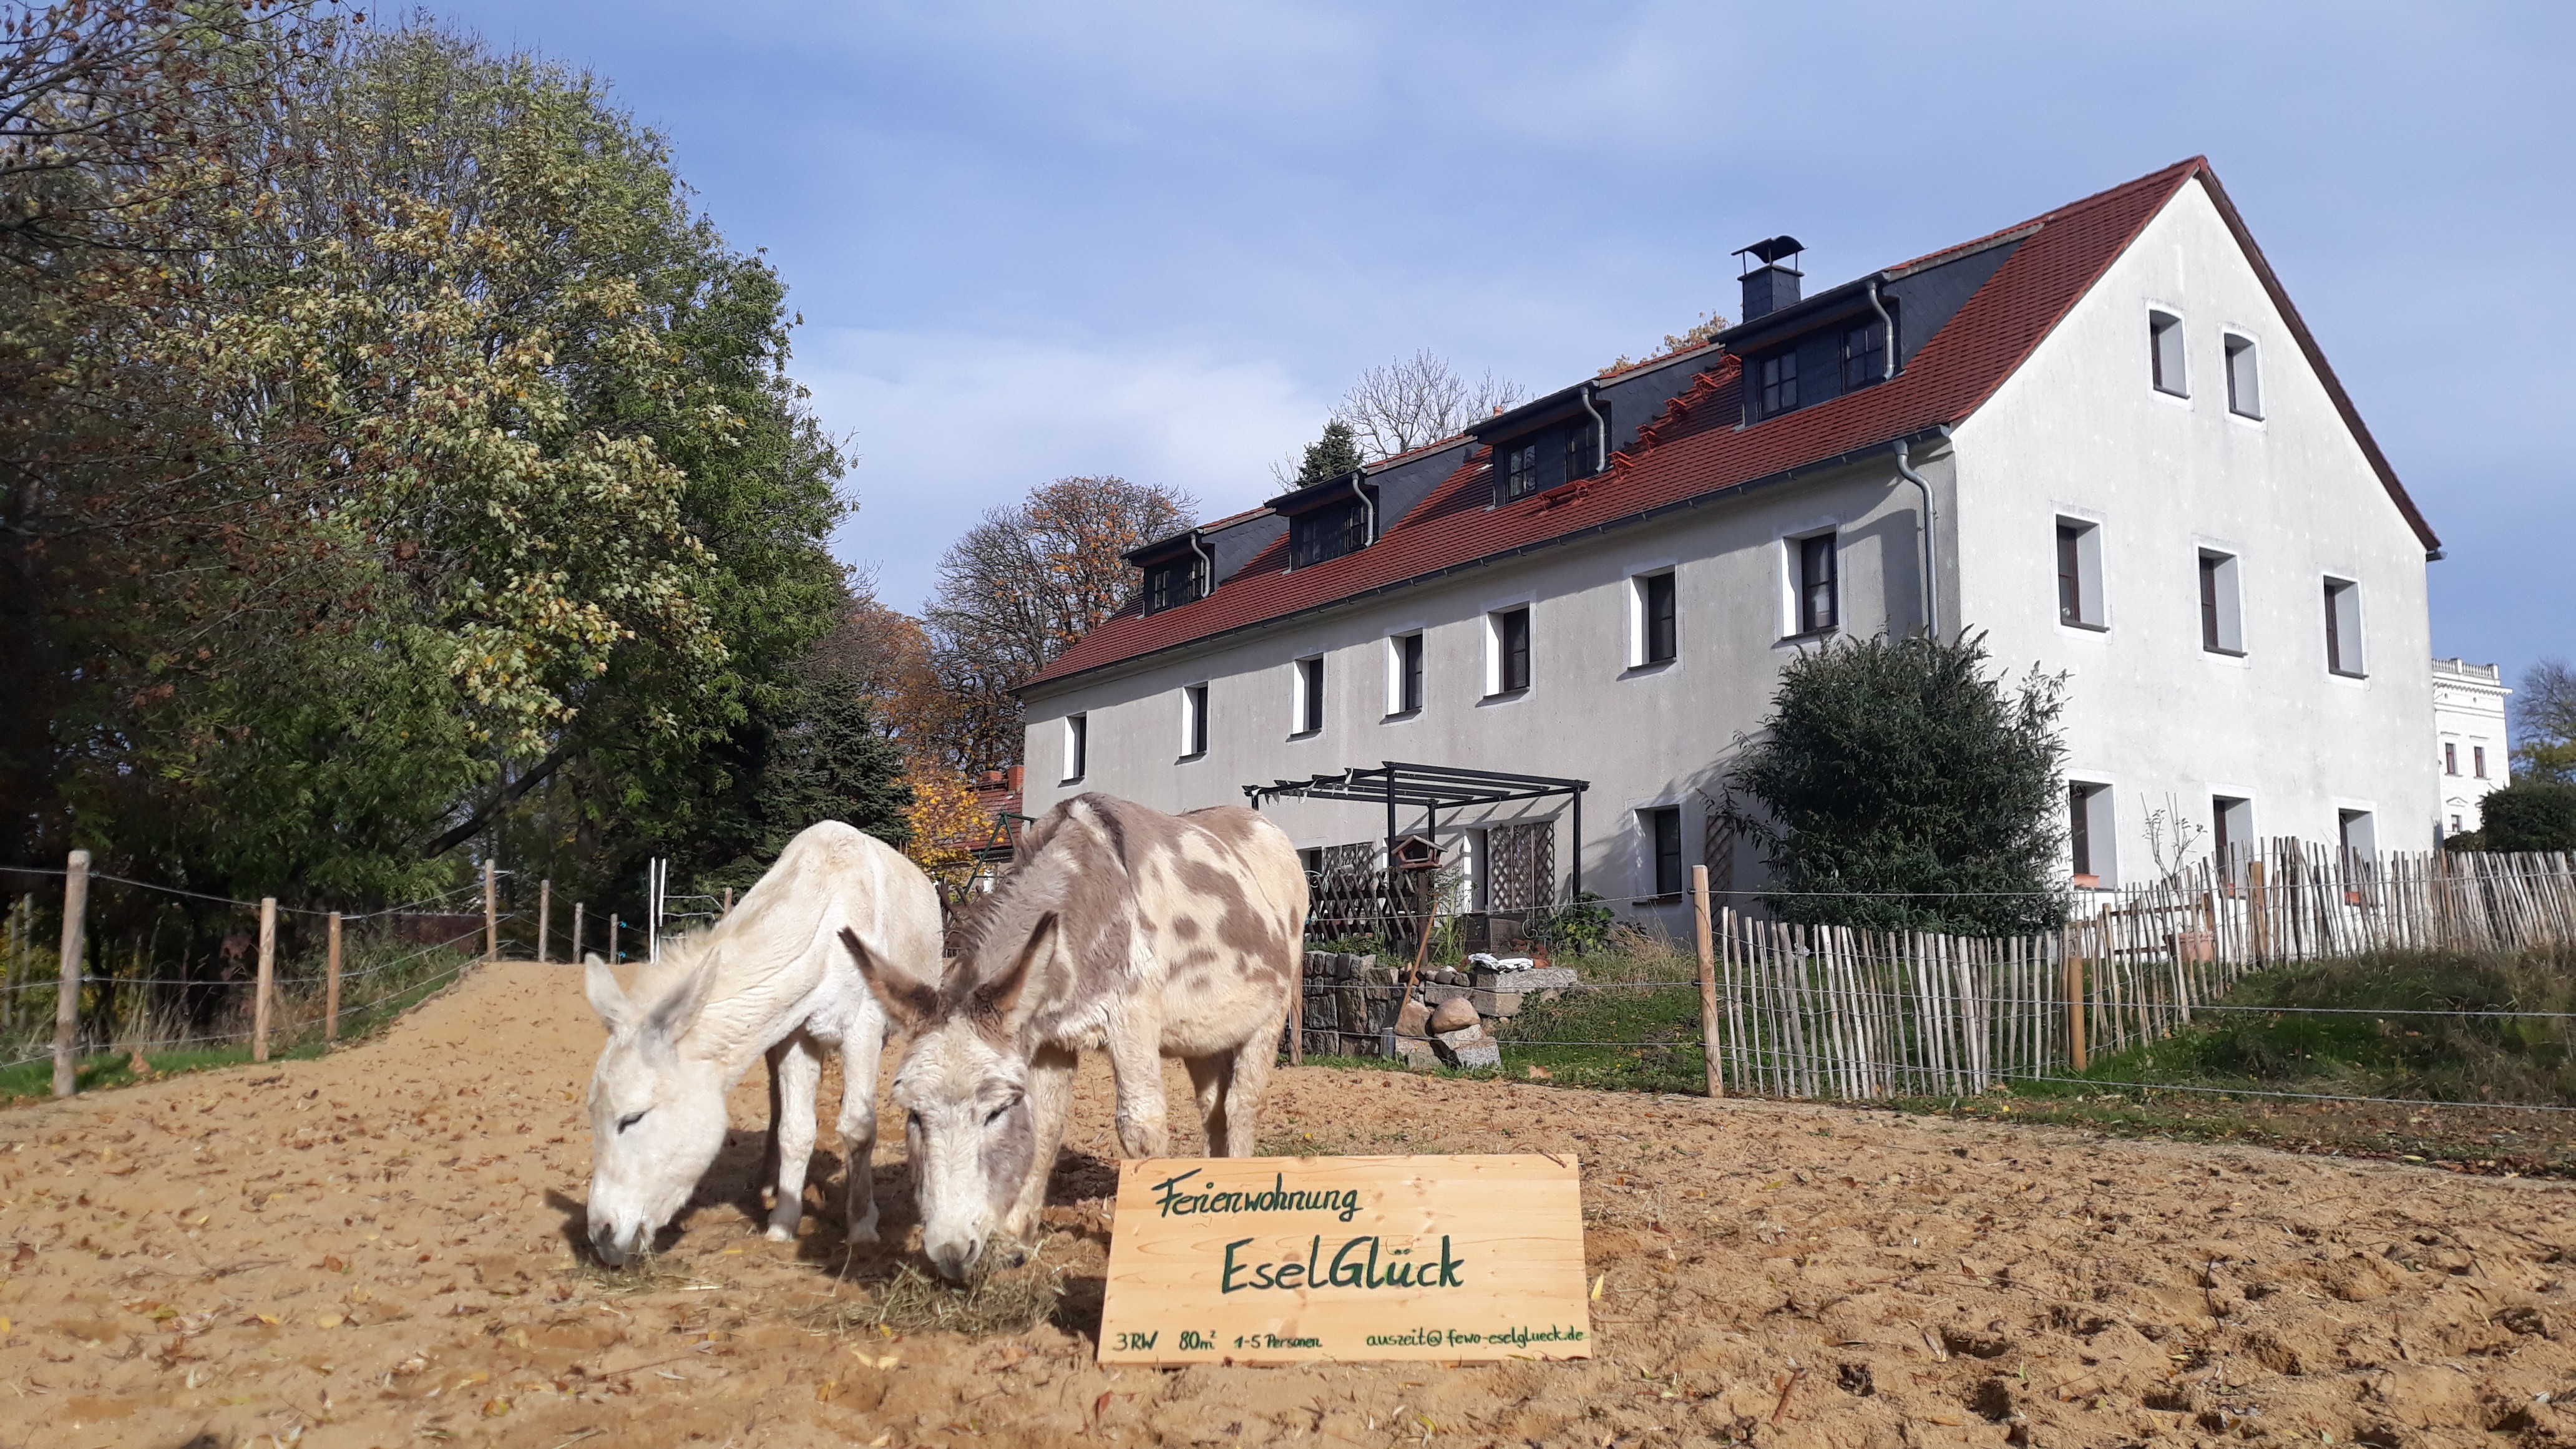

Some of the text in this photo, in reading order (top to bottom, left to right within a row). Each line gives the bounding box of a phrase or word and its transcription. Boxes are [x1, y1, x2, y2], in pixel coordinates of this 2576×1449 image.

[1151, 1168, 1363, 1221] Ferienwohnung
[1221, 1235, 1465, 1294] EselGlück
[1234, 1334, 1261, 1349] 1-5
